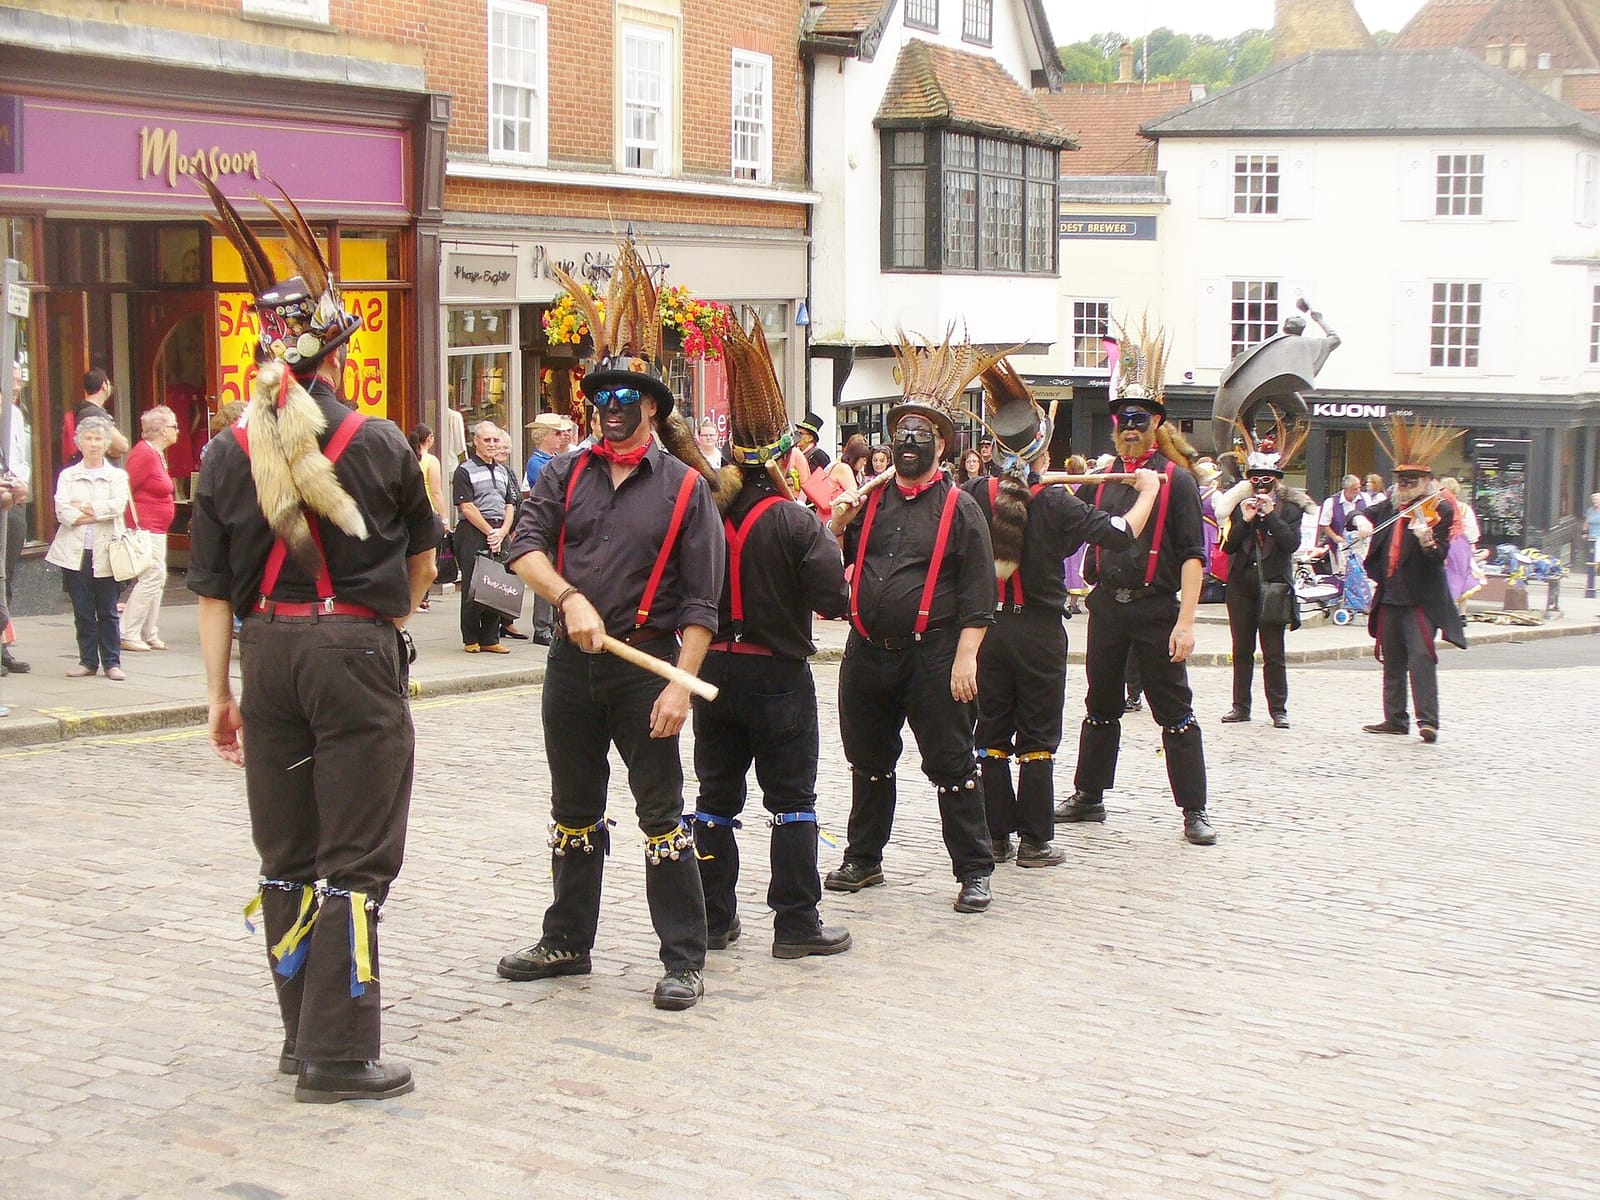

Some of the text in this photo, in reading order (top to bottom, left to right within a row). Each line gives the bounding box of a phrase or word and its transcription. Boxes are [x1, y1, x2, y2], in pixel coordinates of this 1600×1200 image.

[138, 125, 261, 188] Monsoon
[1060, 223, 1127, 233] DEST BREWER
[1313, 403, 1387, 418] KUONI
